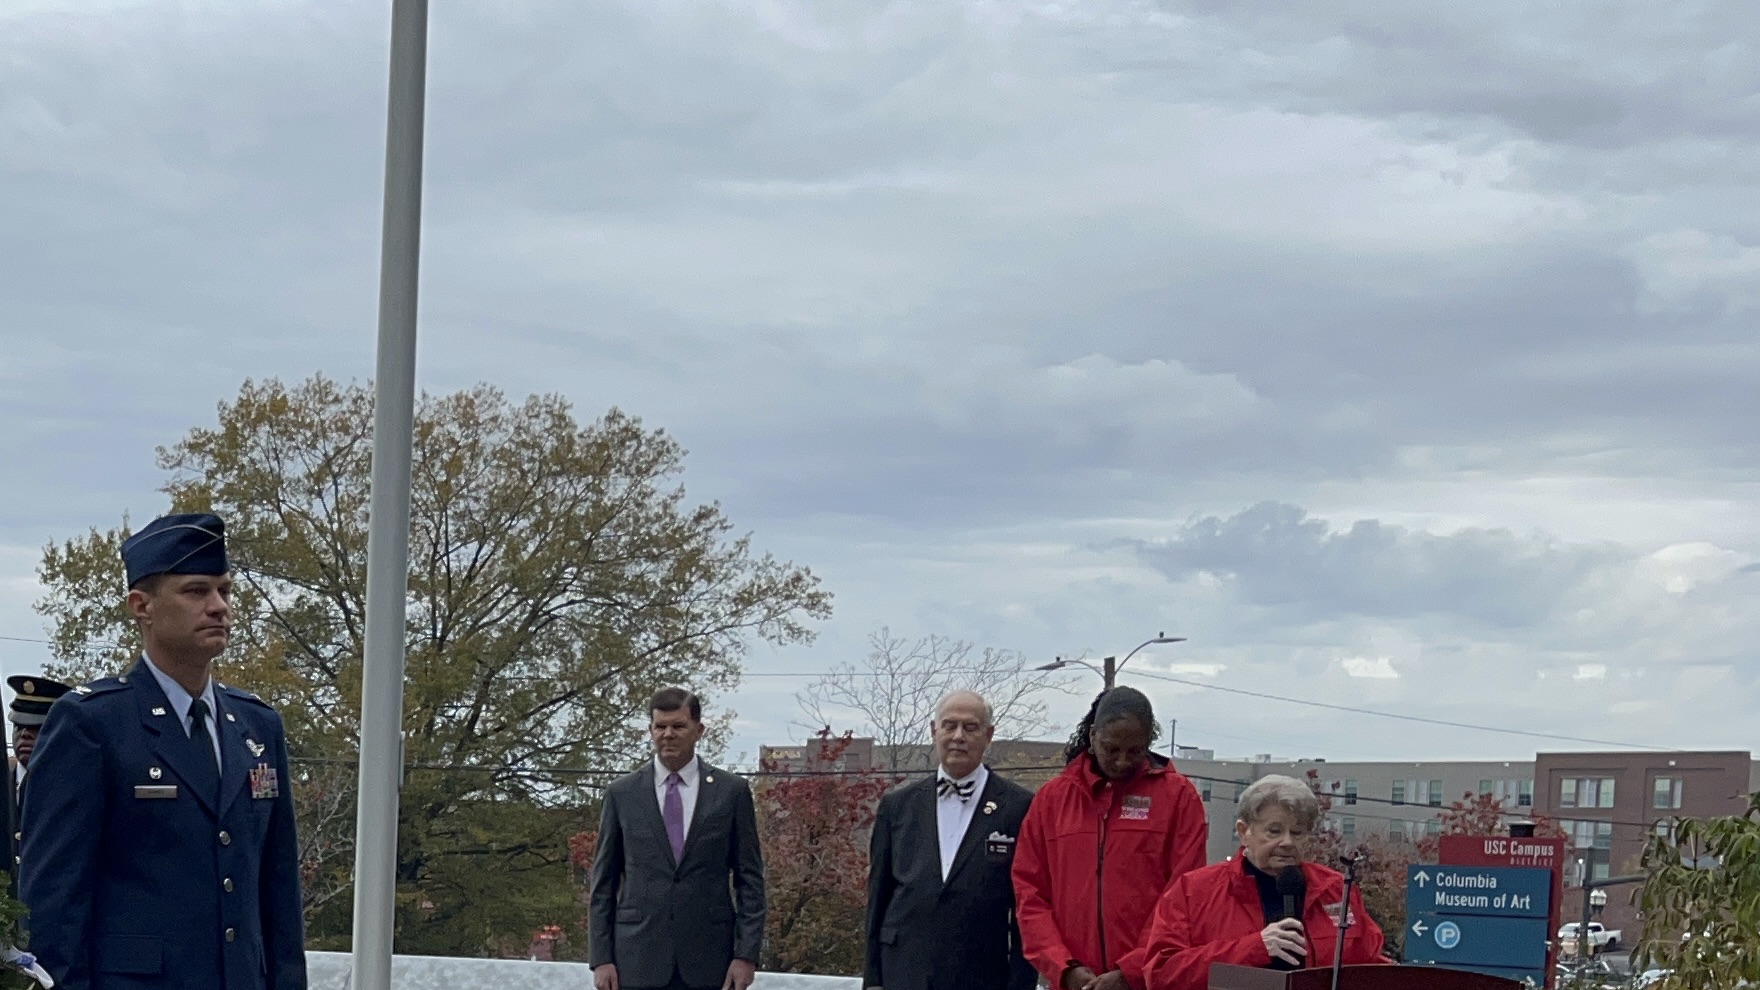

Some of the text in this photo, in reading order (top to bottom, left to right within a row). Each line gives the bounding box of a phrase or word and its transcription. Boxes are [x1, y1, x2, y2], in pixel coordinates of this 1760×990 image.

[1484, 840, 1554, 858] USC Campus
[1436, 872, 1497, 888] Columbia
[1435, 891, 1531, 910] Museum of Art
